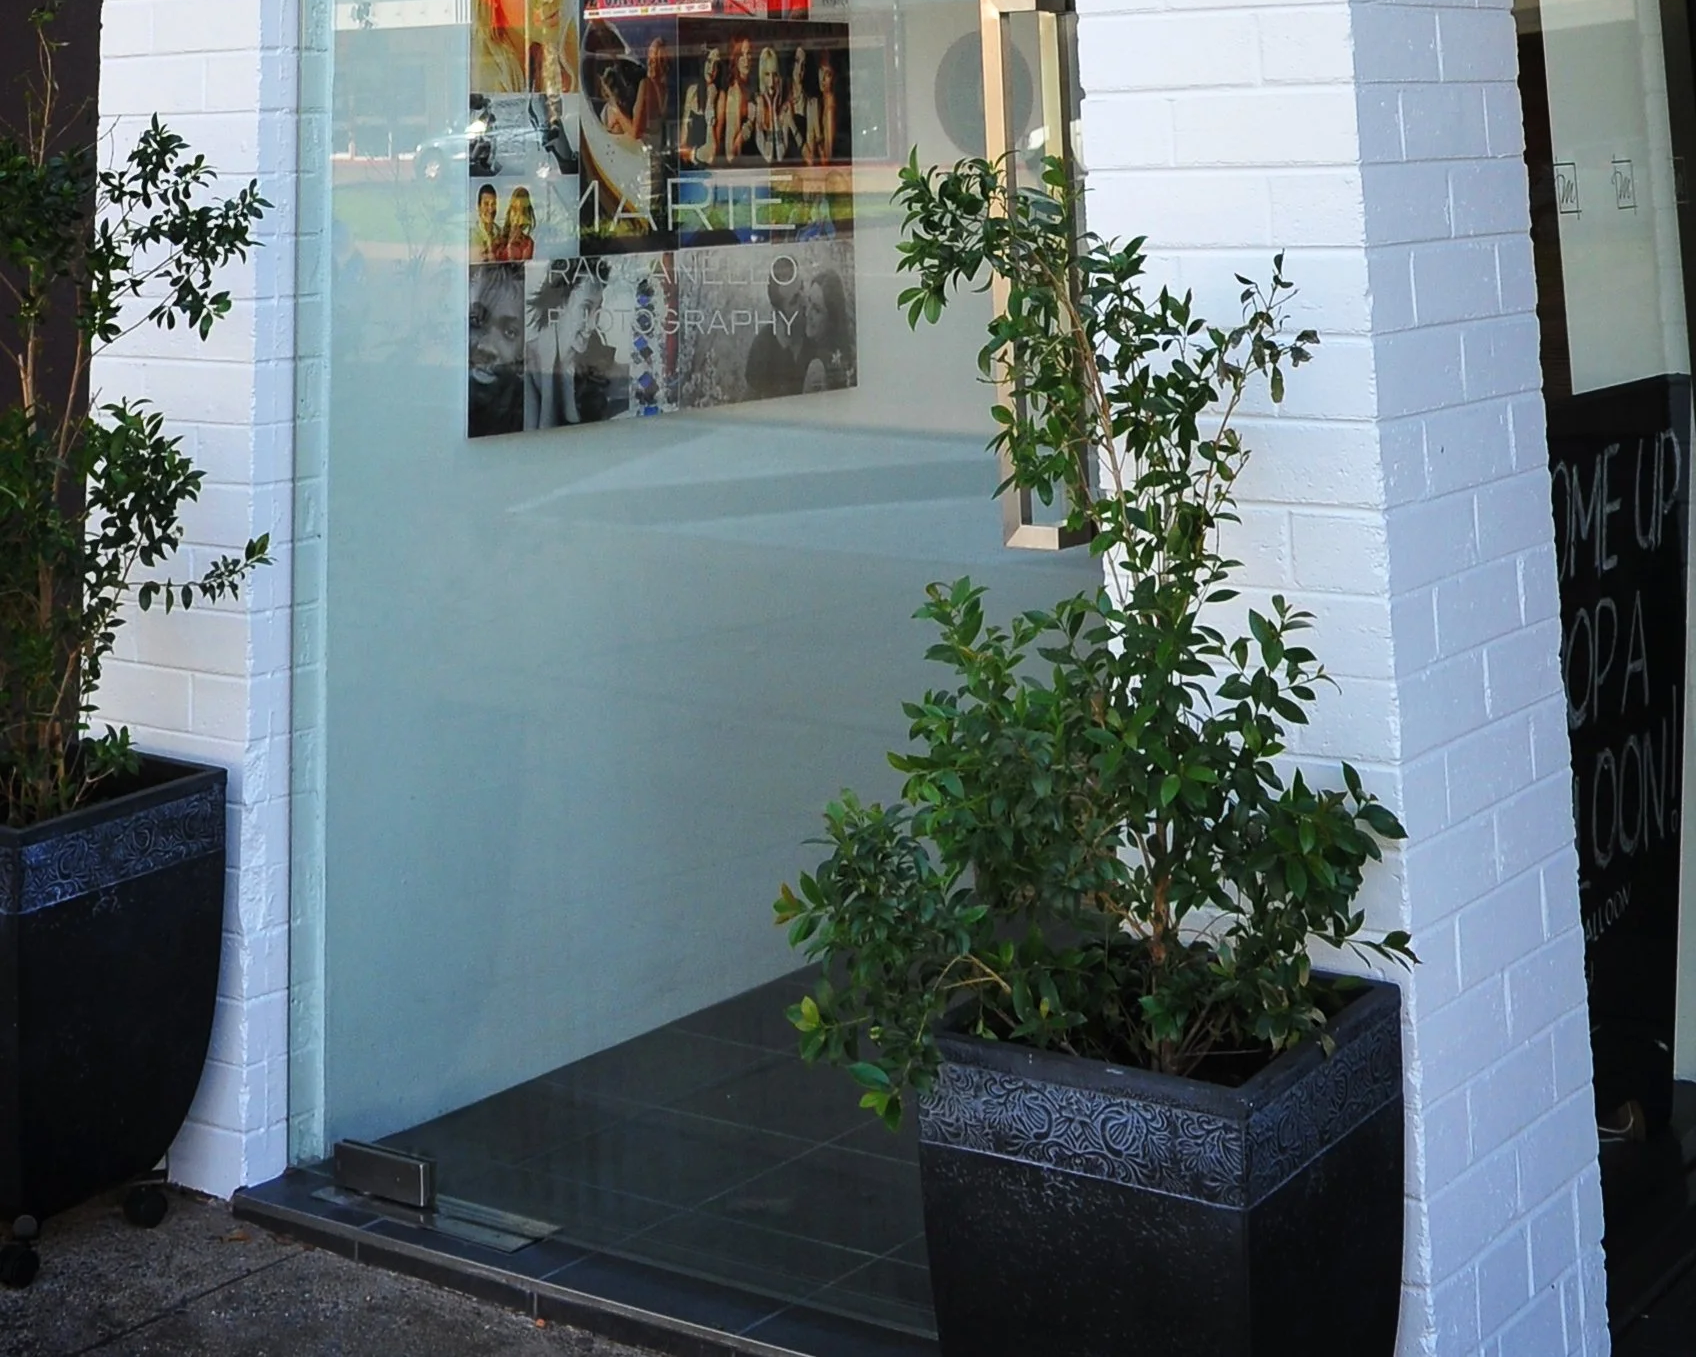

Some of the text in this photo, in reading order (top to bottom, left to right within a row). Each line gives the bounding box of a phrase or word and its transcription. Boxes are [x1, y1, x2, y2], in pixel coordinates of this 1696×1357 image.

[545, 174, 796, 232] MARIE
[548, 255, 799, 286] RACCANELLO
[547, 309, 799, 336] PHOTOGRAPHY
[1635, 428, 1682, 551] UP
[1621, 590, 1650, 715] A
